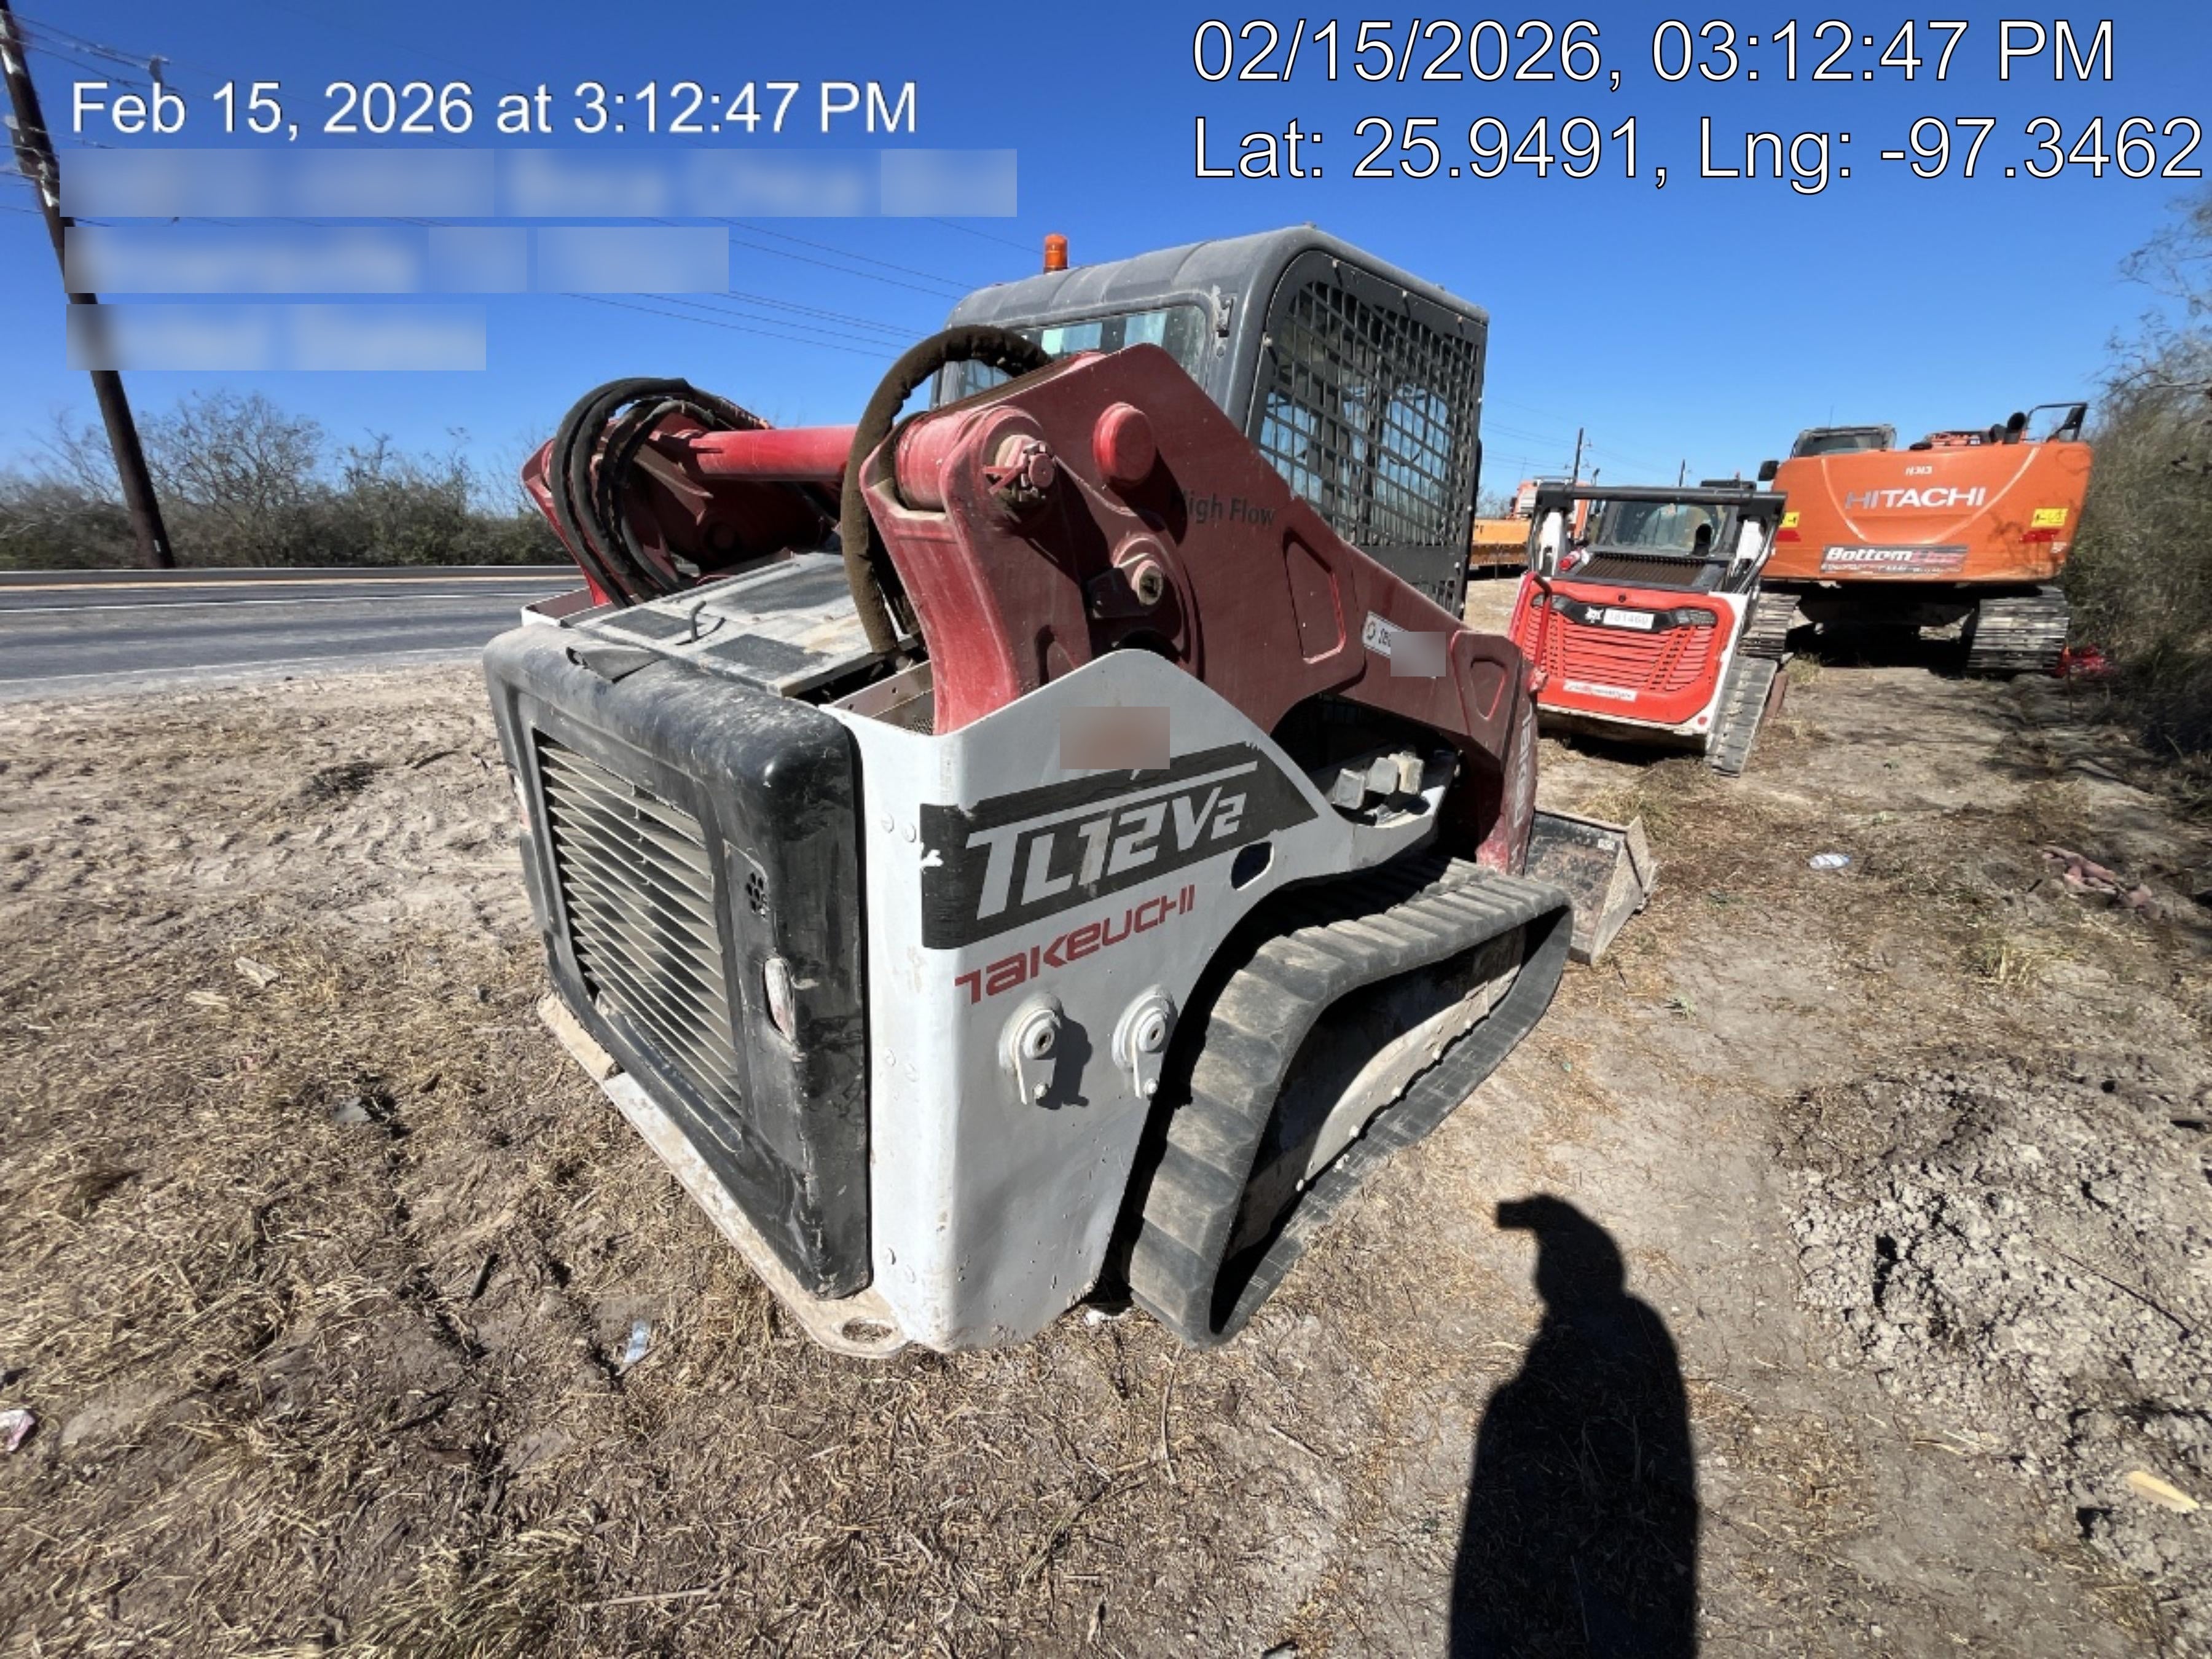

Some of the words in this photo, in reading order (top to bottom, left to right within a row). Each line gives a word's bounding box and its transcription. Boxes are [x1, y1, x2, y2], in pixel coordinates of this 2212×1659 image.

[1230, 496, 1276, 526] Flow
[1845, 487, 1986, 509] HITACHI
[1826, 547, 1913, 562] Bottom
[965, 761, 1258, 921] TL12V2
[955, 884, 1196, 1005] TAKEUCHI
